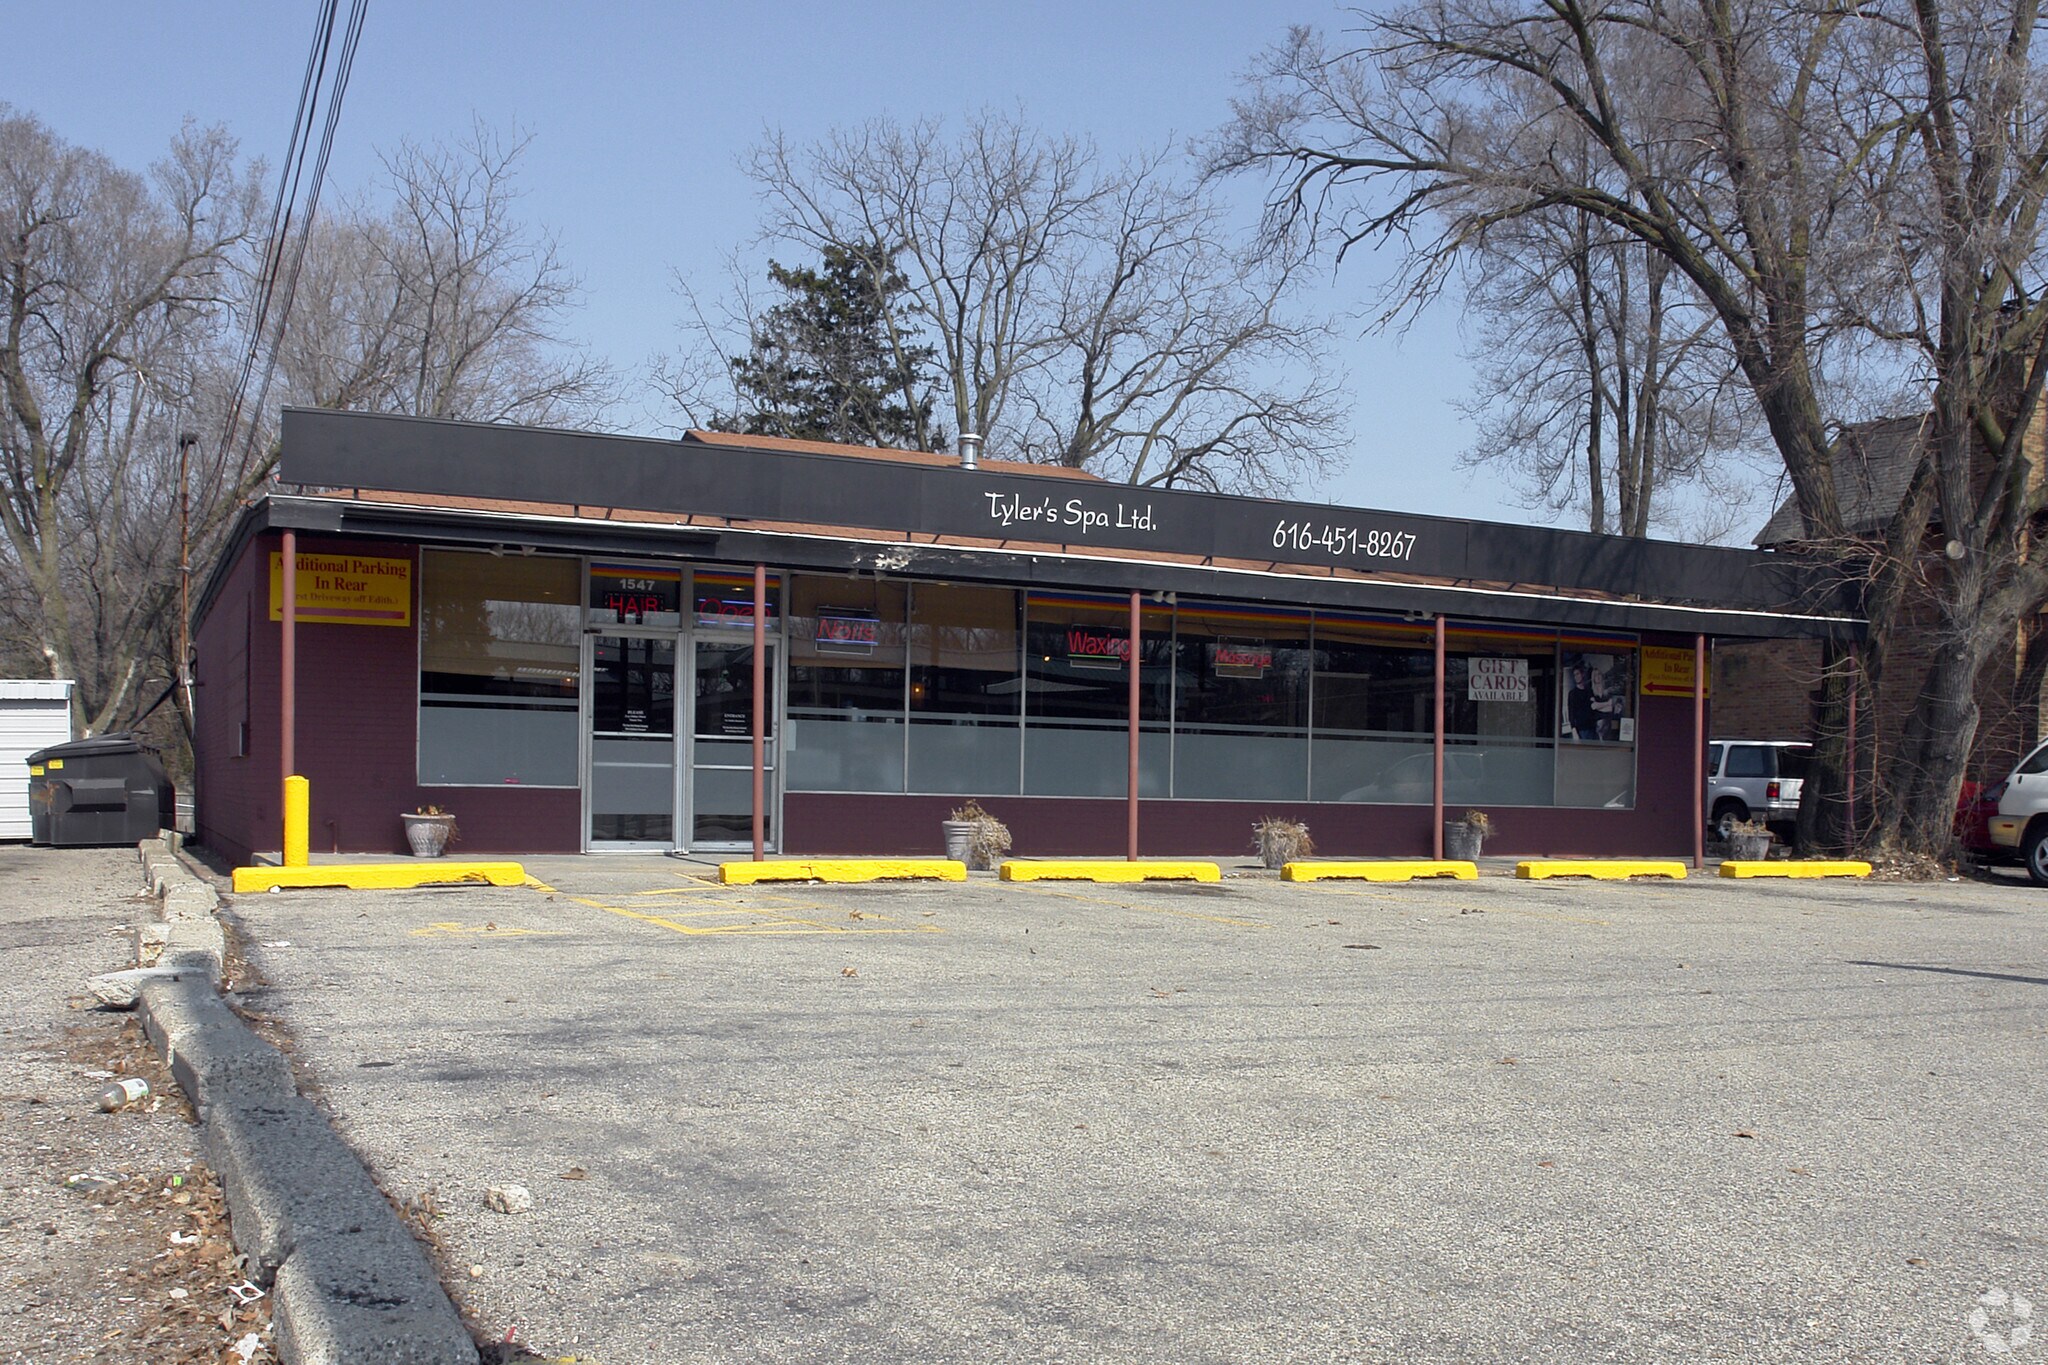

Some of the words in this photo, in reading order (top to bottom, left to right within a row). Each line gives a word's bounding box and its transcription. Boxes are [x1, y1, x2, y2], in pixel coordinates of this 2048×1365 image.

[984, 492, 1058, 526] Tyler's
[1063, 499, 1109, 534] Spa
[1115, 503, 1157, 531] Ltd.
[1272, 519, 1416, 561] 616-451-8267
[275, 557, 348, 573] Aditional
[352, 560, 407, 579] Parking
[315, 575, 330, 590] In
[334, 576, 368, 592] Rear
[620, 578, 655, 591] 1547
[1478, 658, 1519, 674] GIFT
[1470, 674, 1527, 691] CARDS
[1472, 690, 1525, 701] AVAILABLE
